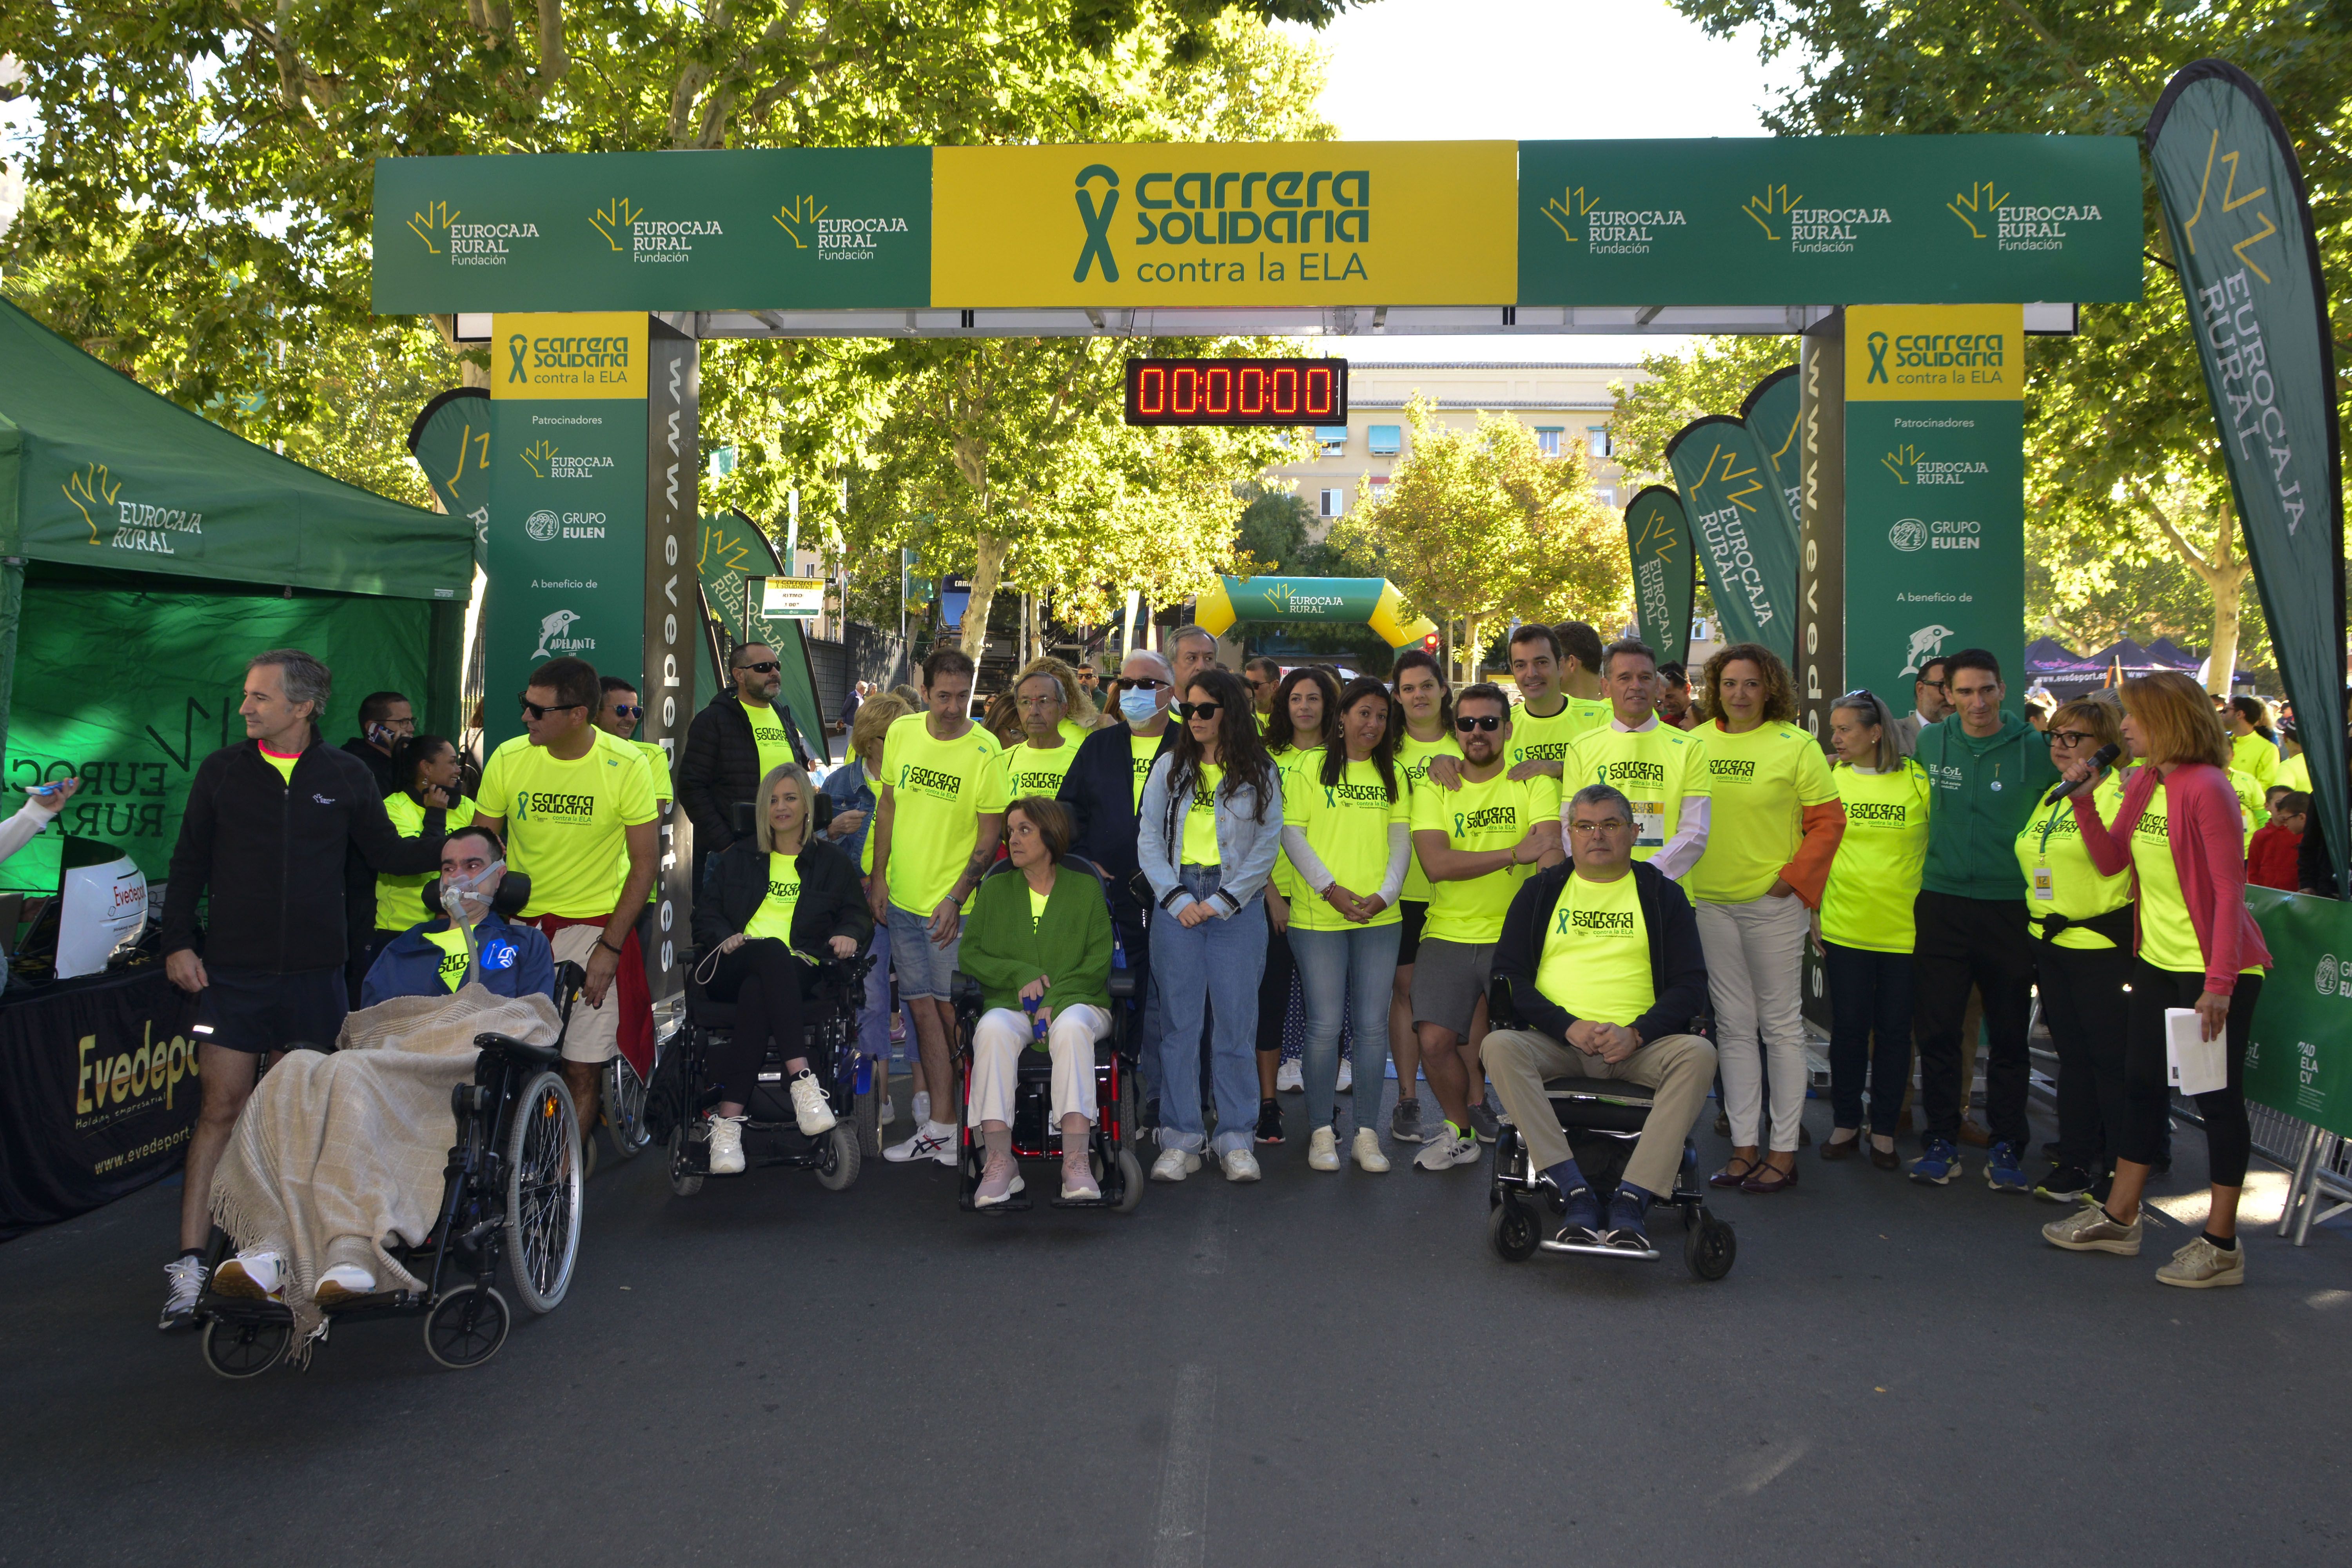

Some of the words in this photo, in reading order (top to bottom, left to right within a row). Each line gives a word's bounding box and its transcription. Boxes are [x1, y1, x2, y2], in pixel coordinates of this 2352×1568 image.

[1589, 211, 1686, 225] EUROCAJA
[1791, 209, 1891, 224] EUROCAJA
[1998, 206, 2102, 222] EUROCAJA
[451, 223, 539, 239] EUROCAJA
[633, 221, 723, 236] EUROCAJA
[818, 218, 908, 234] EUROCAJA
[1791, 225, 1857, 240] RURAL
[1998, 223, 2065, 238] RURAL
[1589, 227, 1653, 241] RURAL
[451, 239, 509, 254] RURAL
[633, 236, 692, 251] RURAL
[818, 234, 877, 249] RURAL
[1590, 242, 1649, 254] Fundación
[1792, 241, 1853, 253] Fundación
[1998, 238, 2062, 251] Fundación
[452, 253, 506, 266] Fundación
[634, 251, 689, 263] Fundación
[818, 249, 873, 261] Fundación
[1137, 257, 1244, 283] contra
[1260, 252, 1285, 282] la
[1300, 252, 1368, 280] ELA
[534, 372, 578, 383] contra
[584, 370, 594, 383] la
[600, 371, 627, 383] ELA
[1896, 372, 1946, 384] contra
[1953, 370, 1965, 383] la
[1972, 370, 2002, 383] ELA
[2199, 280, 2262, 461] RURAL
[1140, 368, 1330, 413] 00:00:00
[2224, 269, 2306, 536] EUROCAJA
[532, 416, 602, 425] Patrocinadores
[1895, 418, 1974, 428] Patrocinadores
[552, 457, 614, 467] EUROCAJA
[1917, 462, 1989, 472] EUROCAJA
[552, 468, 592, 477] RURAL
[1917, 474, 1964, 484] RURAL
[118, 502, 202, 534] EUROCAJA
[563, 513, 606, 524] GRUPO
[563, 527, 604, 538] EULEN
[1931, 521, 1980, 534] GRUPO
[112, 527, 174, 554] RURAL
[1931, 537, 1979, 549] EULEN
[1699, 511, 1739, 592] RURAL
[1719, 505, 1773, 627] EUROCAJA
[541, 580, 583, 588] beneficio
[586, 580, 597, 588] de
[1290, 597, 1343, 605] EUROCAJA
[1639, 562, 1658, 626] RURAL
[1896, 593, 1905, 601] A
[1908, 593, 1955, 602] beneficio
[1959, 593, 1972, 602] de
[1650, 558, 1674, 652] EUROCAJA
[550, 638, 596, 650] ADELANTE
[2301, 1056, 2318, 1073] ELA
[2300, 1071, 2312, 1084] CV
[76, 1114, 109, 1130] Holding
[115, 1092, 166, 1116] empresarial
